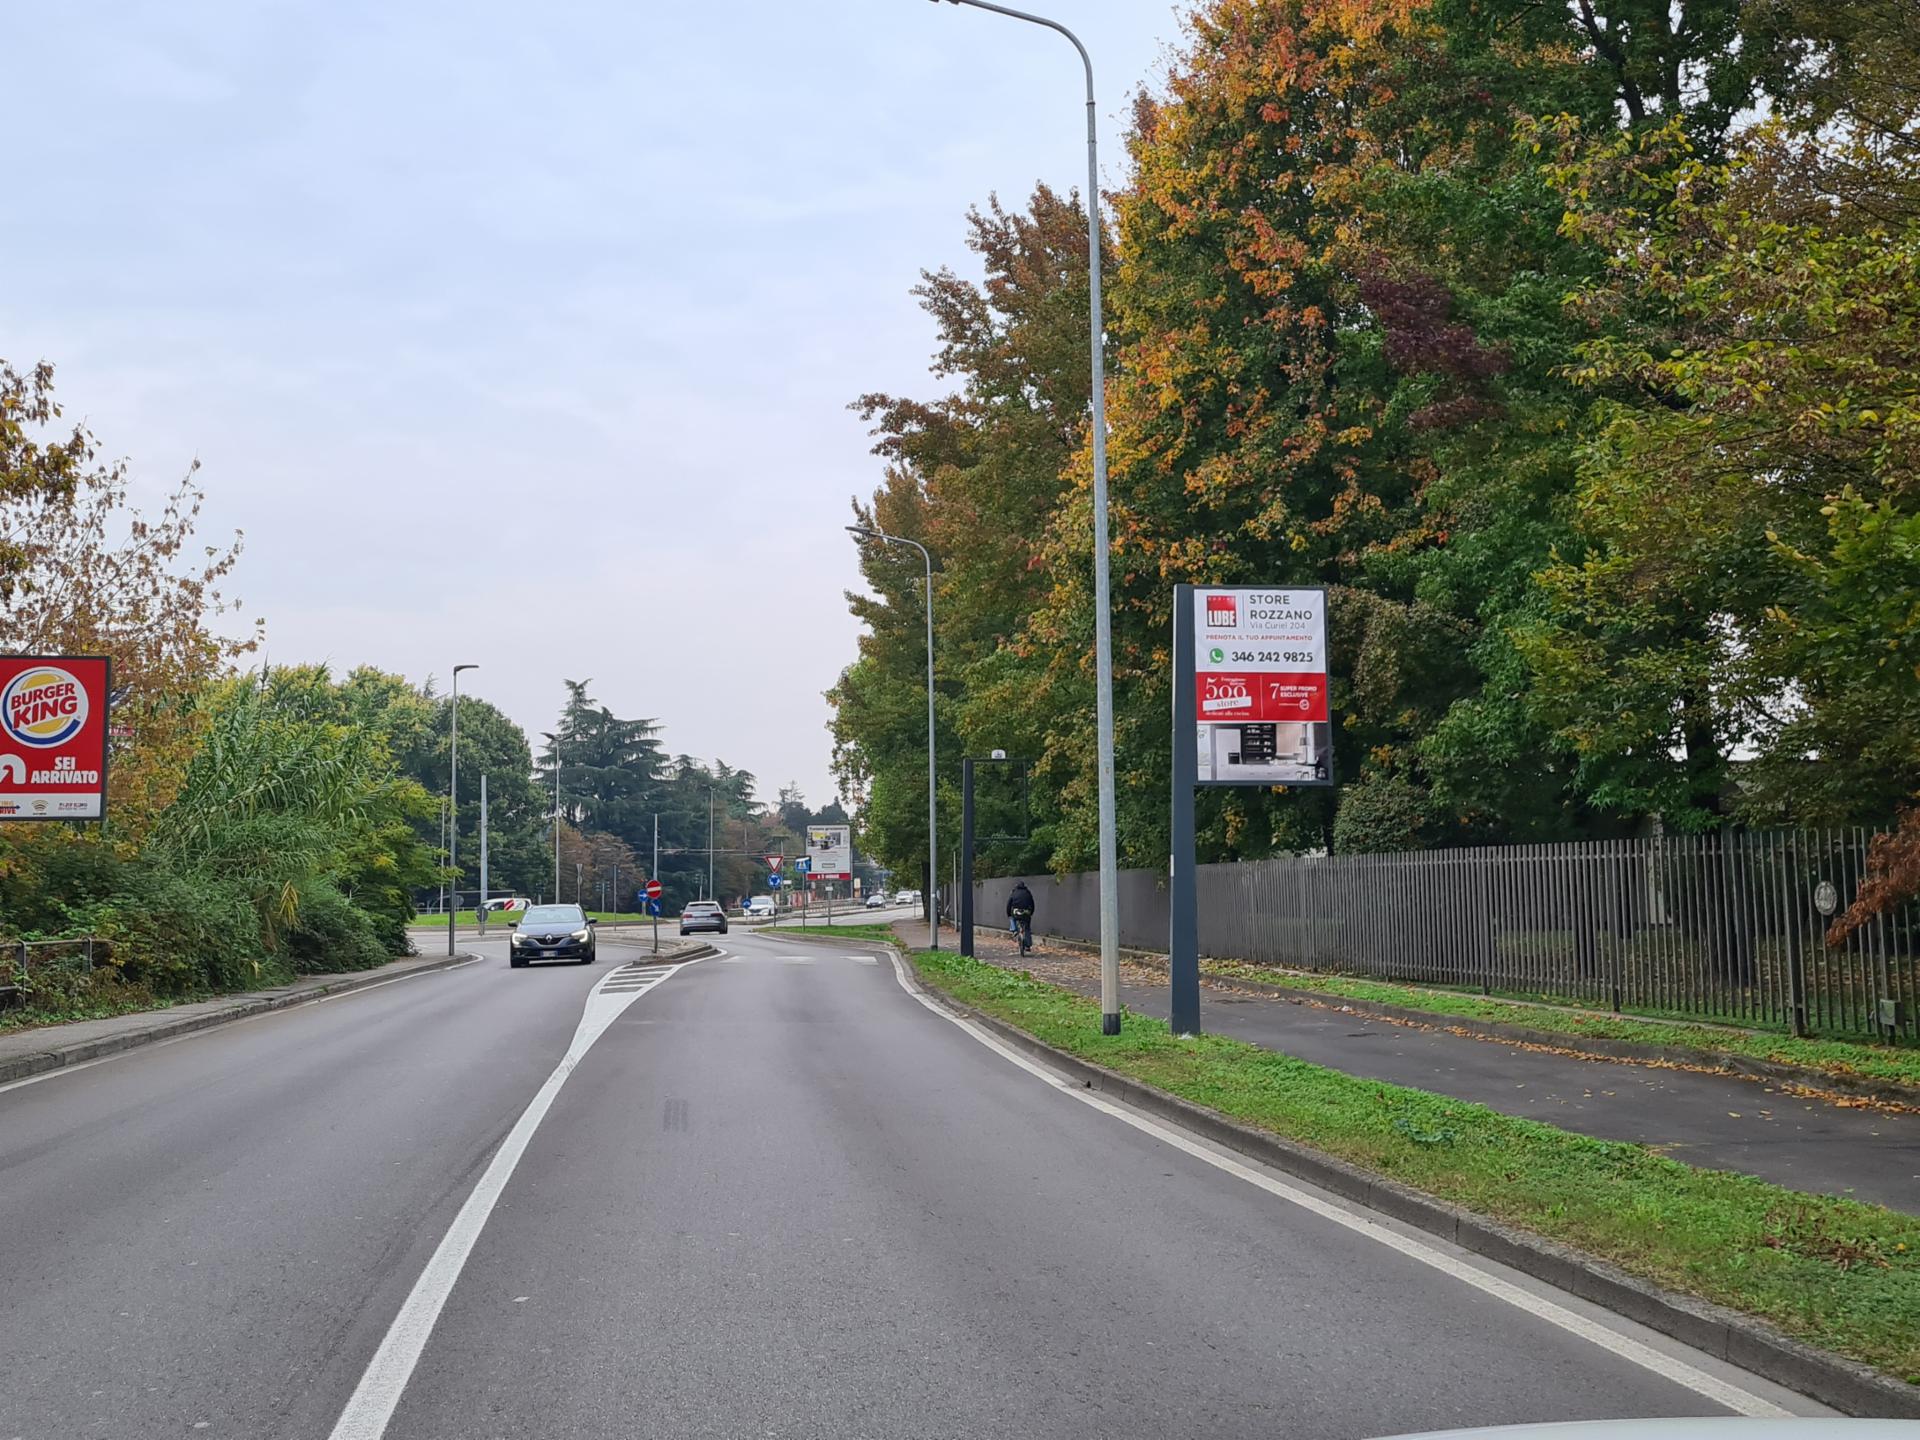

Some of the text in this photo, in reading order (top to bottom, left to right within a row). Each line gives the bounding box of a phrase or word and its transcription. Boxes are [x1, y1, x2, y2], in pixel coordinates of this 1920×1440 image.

[1249, 595, 1290, 605] STORE
[1208, 610, 1236, 626] LUBE
[1250, 610, 1313, 620] ROZZANO
[1250, 621, 1263, 629] Via
[1290, 622, 1306, 630] 204
[1231, 651, 1313, 663] 346 242 9825
[1205, 677, 1247, 699] 500
[1270, 683, 1280, 700] 7
[11, 682, 75, 710] BURGER
[1216, 699, 1239, 708] store
[13, 695, 77, 730] KING
[54, 756, 76, 771] SEI
[31, 770, 98, 785] ARRIVATO
